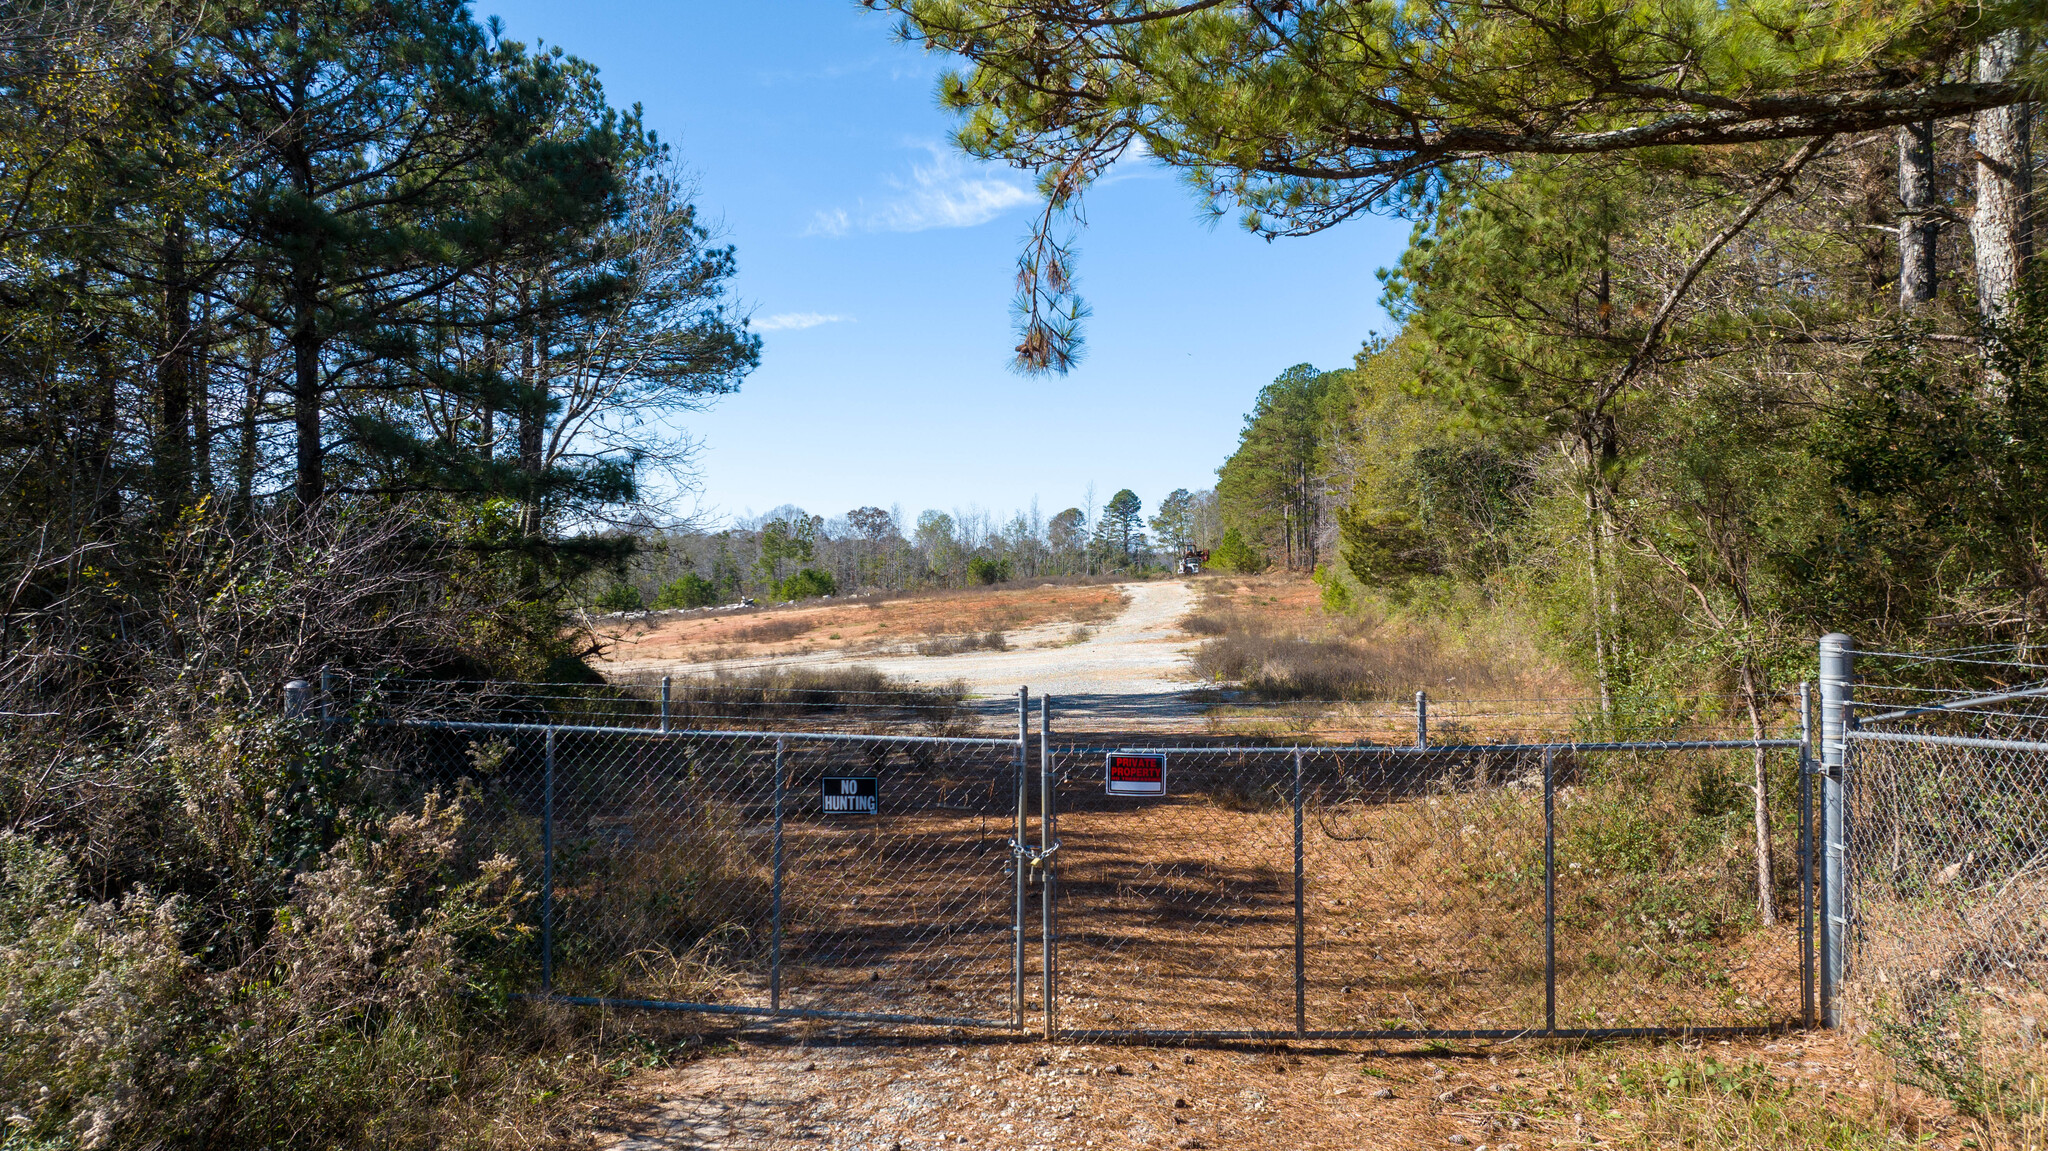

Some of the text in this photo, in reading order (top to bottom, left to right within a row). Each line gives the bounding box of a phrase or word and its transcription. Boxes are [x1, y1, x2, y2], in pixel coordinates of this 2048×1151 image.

[1116, 758, 1156, 767] PRIVATE
[1111, 767, 1161, 777] PROPERTY
[841, 779, 857, 795] NO
[824, 795, 875, 811] HUNTING
